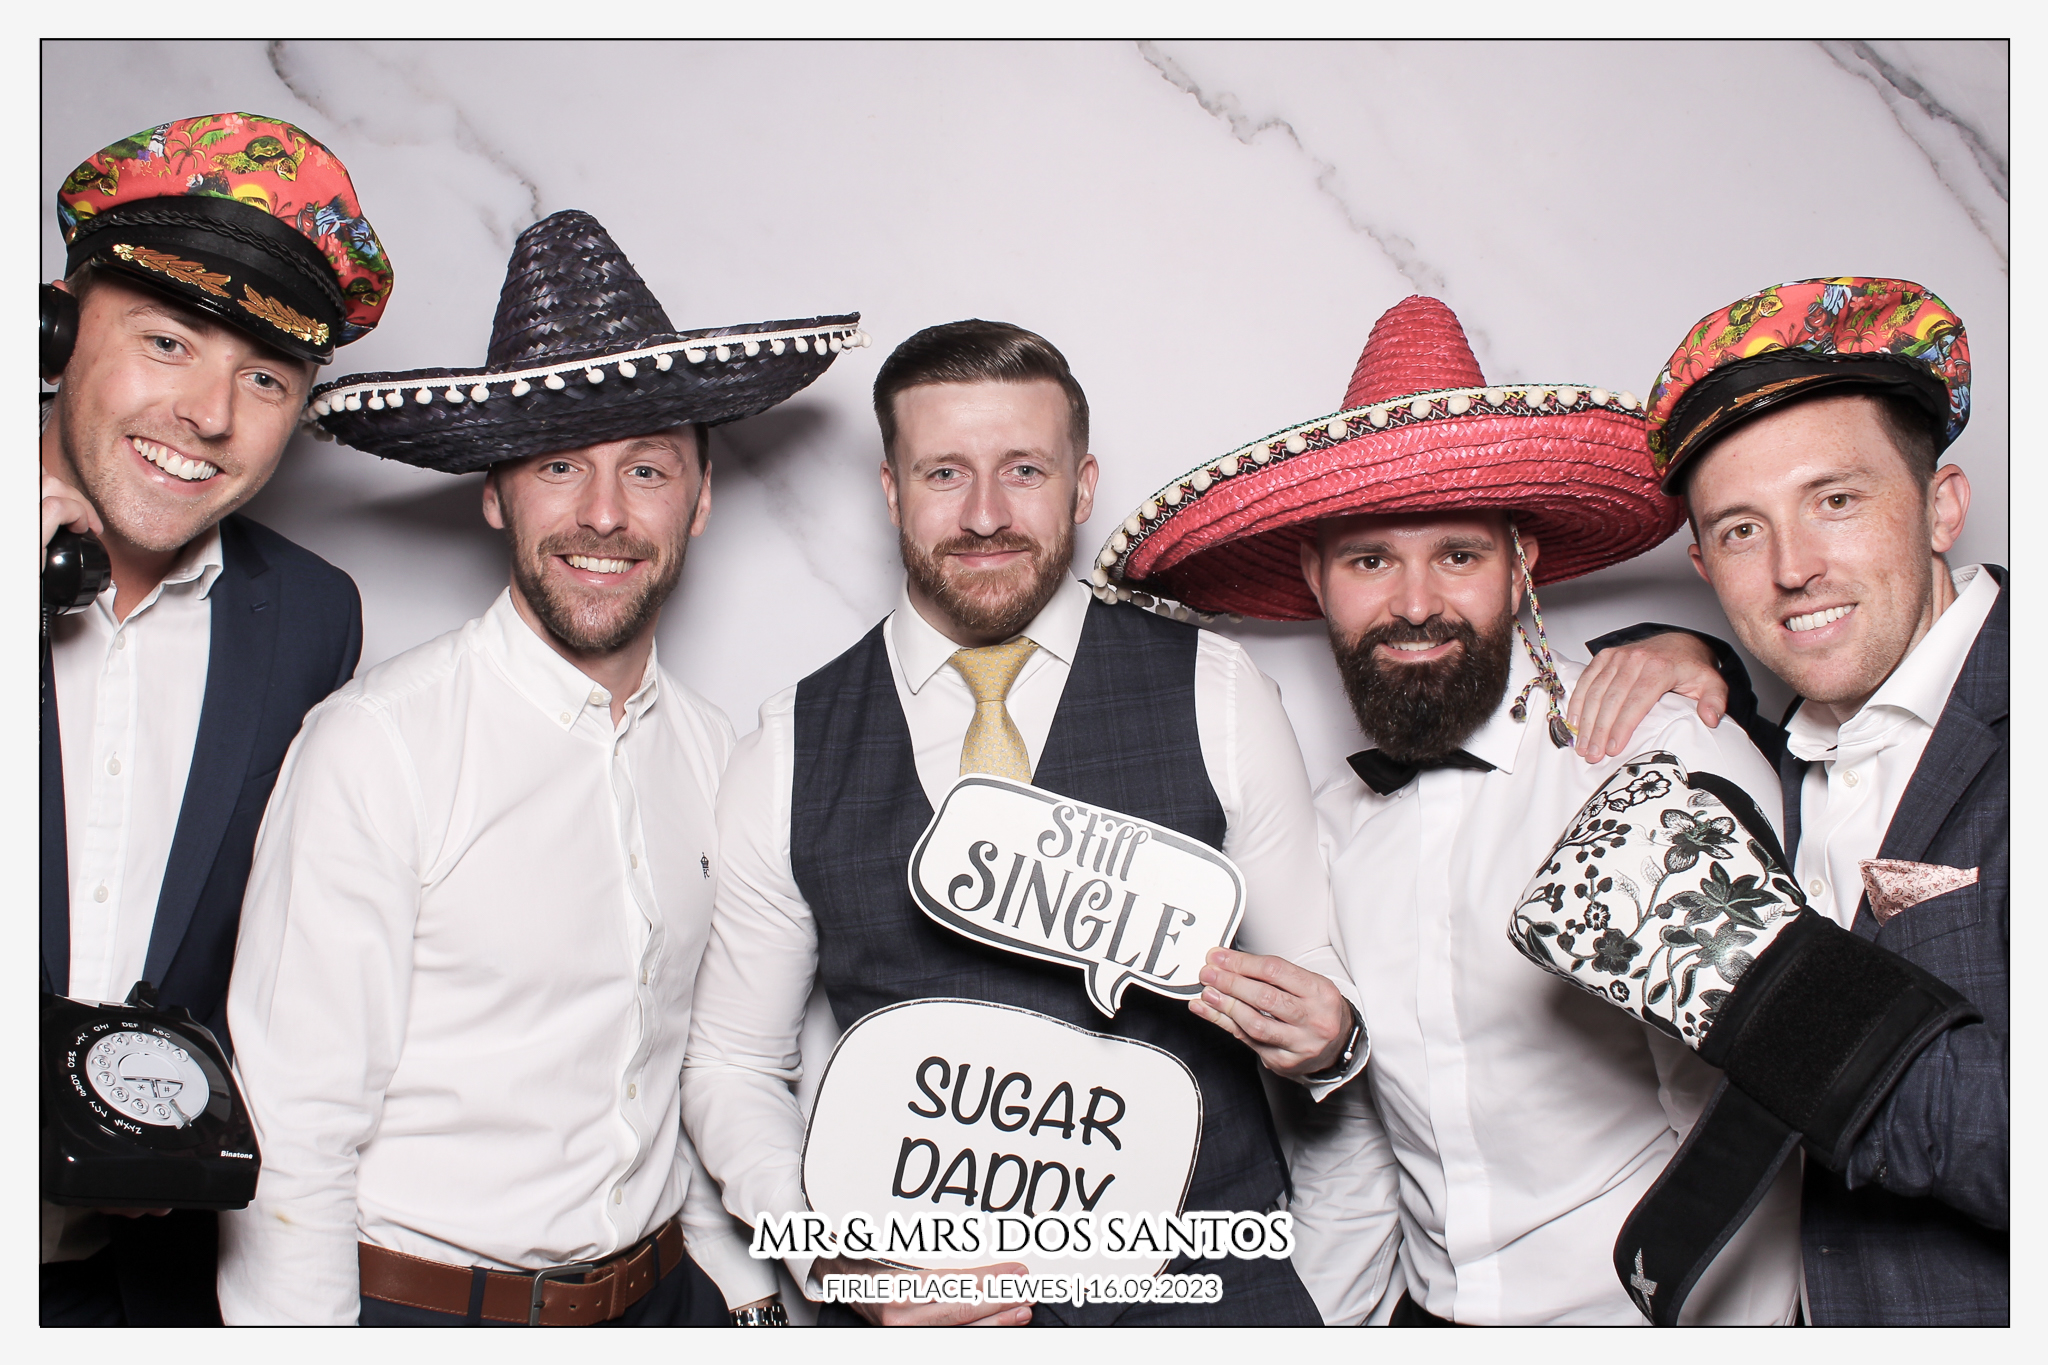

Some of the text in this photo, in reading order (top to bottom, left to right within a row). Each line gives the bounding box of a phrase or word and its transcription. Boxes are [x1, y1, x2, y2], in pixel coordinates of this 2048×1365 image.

[1037, 804, 1150, 882] Still
[948, 840, 1196, 981] SINGLE
[93, 1023, 110, 1032] GHI
[121, 1021, 139, 1029] DEF
[152, 1027, 171, 1039] ABC
[67, 1051, 77, 1068] MNO
[89, 1101, 108, 1118] TUV
[907, 1056, 1126, 1150] SUGAR
[114, 1119, 142, 1135] WXYZ
[220, 1150, 254, 1160] Binatone
[892, 1136, 1115, 1218] DADDY
